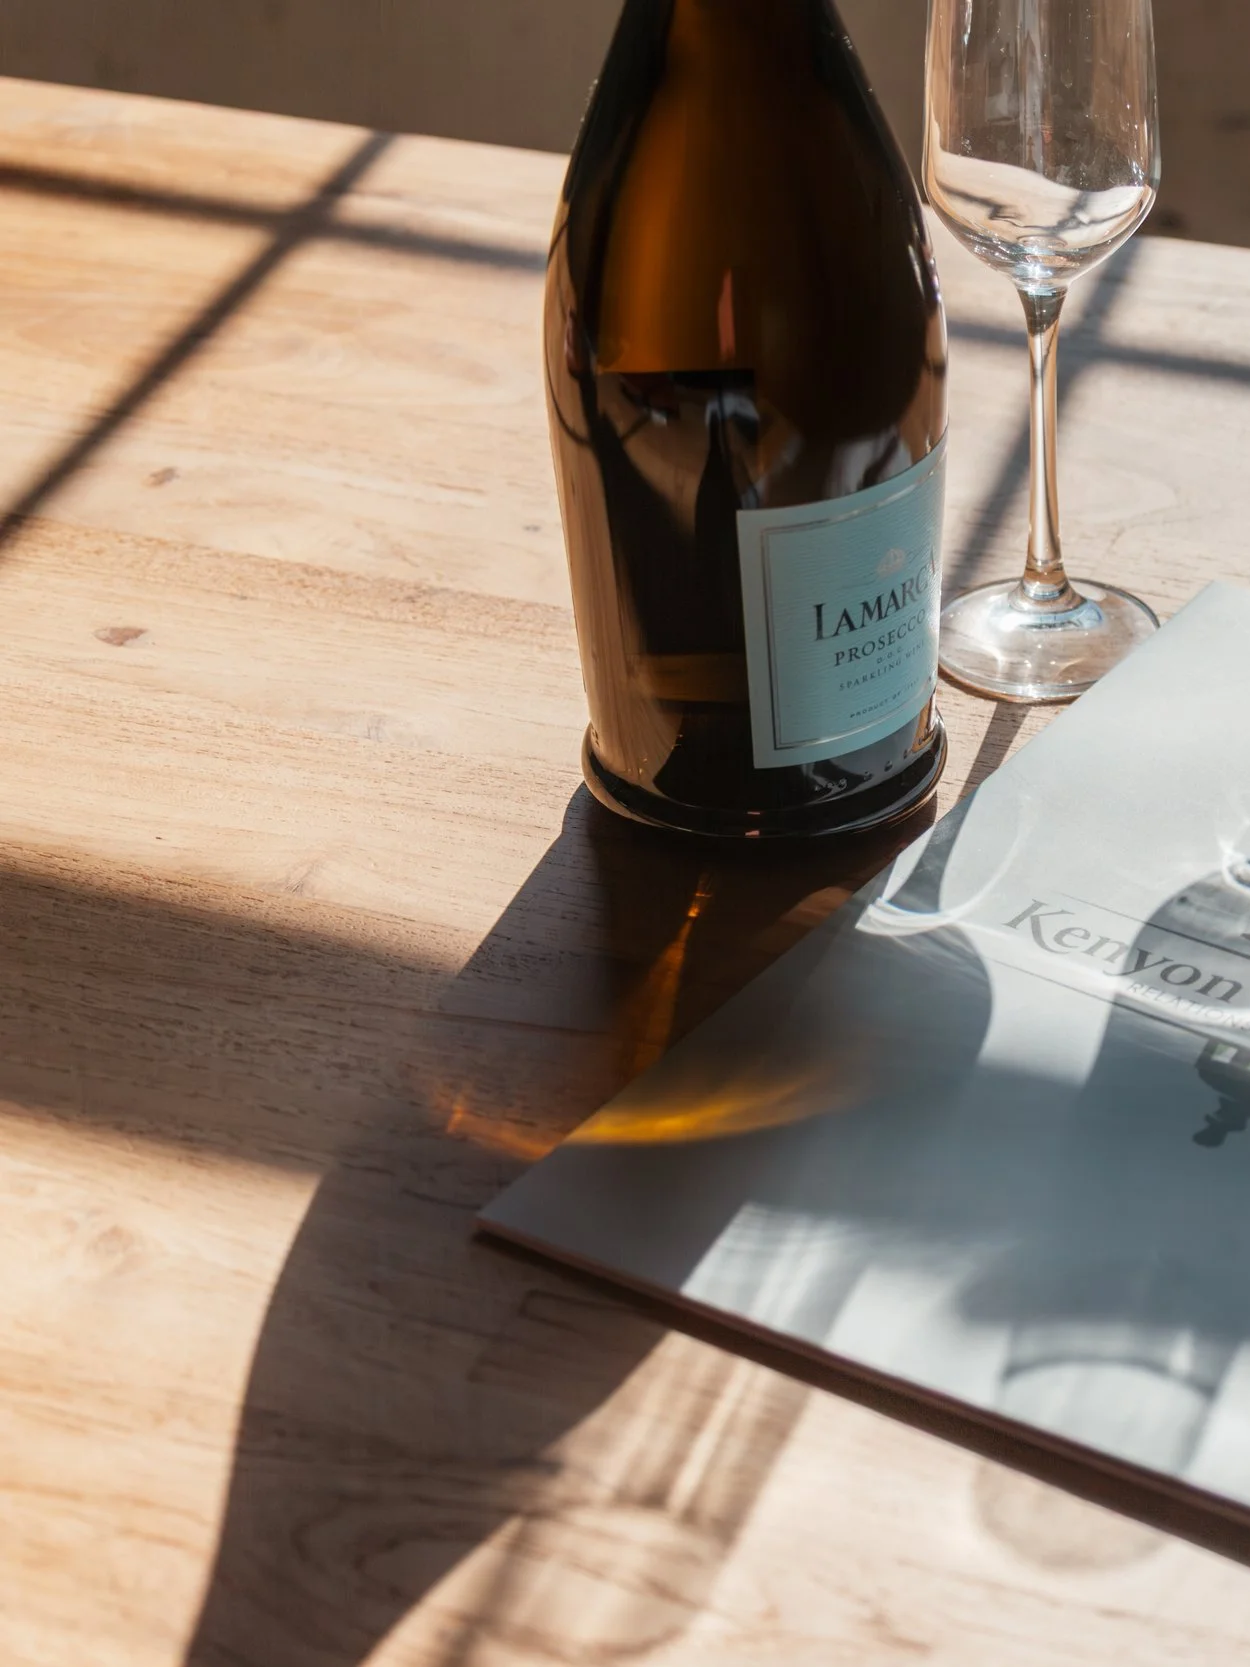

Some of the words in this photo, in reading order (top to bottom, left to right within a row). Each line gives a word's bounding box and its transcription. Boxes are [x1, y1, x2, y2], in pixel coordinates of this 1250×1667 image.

[834, 608, 926, 667] PROSECCO
[839, 659, 902, 691] SPARKLING
[1002, 899, 1243, 1004] Kenyon
